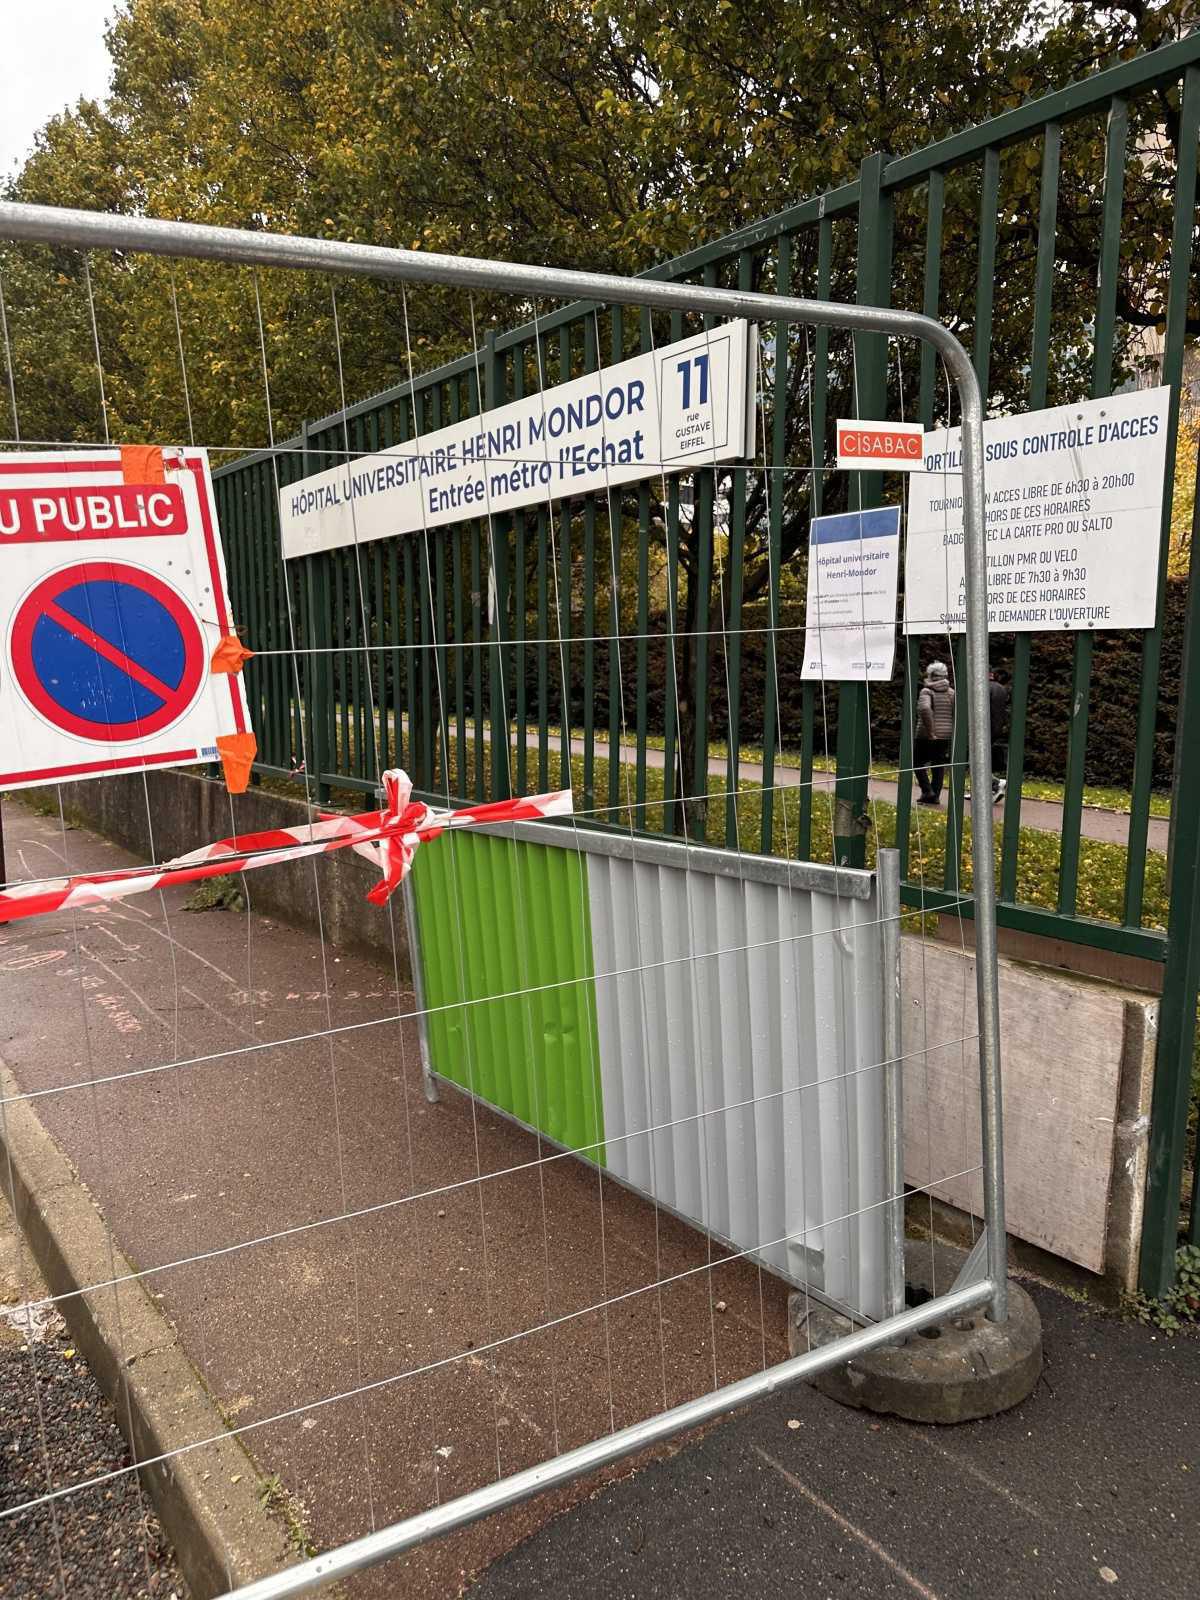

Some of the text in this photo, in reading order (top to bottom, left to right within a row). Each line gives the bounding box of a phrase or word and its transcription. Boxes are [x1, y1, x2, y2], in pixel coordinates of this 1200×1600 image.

[677, 353, 710, 410] 11
[687, 412, 700, 423] rue
[675, 421, 711, 439] GUSTAVE
[986, 440, 1018, 461] SOUS
[1022, 426, 1094, 456] CONTROLE
[1098, 415, 1159, 443] D'ACCES
[291, 379, 645, 517] HÔPITAL UNIVERSITAIRE HENRI MONDOR
[680, 437, 705, 450] EIFFEL
[430, 430, 644, 513] Entrée métro l'Echat
[929, 496, 963, 512] TOURNIQ
[993, 488, 1020, 504] ACCES
[1022, 484, 1049, 500] LIBRE
[1051, 482, 1063, 496] DE
[1065, 479, 1090, 494] 6h30
[1093, 479, 1099, 491] à
[1102, 472, 1135, 490] 20h00
[0, 492, 174, 535] U PUBLIC
[1010, 506, 1022, 520] DE
[1024, 504, 1041, 518] CES
[1044, 499, 1091, 515] HORAIRES
[943, 533, 964, 546] BADG
[1000, 528, 1011, 540] LA
[1014, 524, 1043, 539] CARTE
[1045, 522, 1064, 536] PRO
[1066, 521, 1079, 534] OU
[1082, 516, 1113, 532] SALTO
[816, 551, 890, 567] Hôpital universitaire
[1017, 551, 1037, 566] PMR
[1039, 550, 1052, 564] OU
[1054, 548, 1078, 562] VELO
[826, 568, 878, 580] Henri-Mondor
[988, 567, 1087, 586] LIBRE DE 7h30 à 9h30
[1006, 591, 1018, 604] DE
[1020, 589, 1037, 603] CES
[1039, 587, 1086, 602] HORAIRES
[998, 608, 1047, 622] DEMANDER
[1049, 606, 1111, 621] L'OUVERTURE
